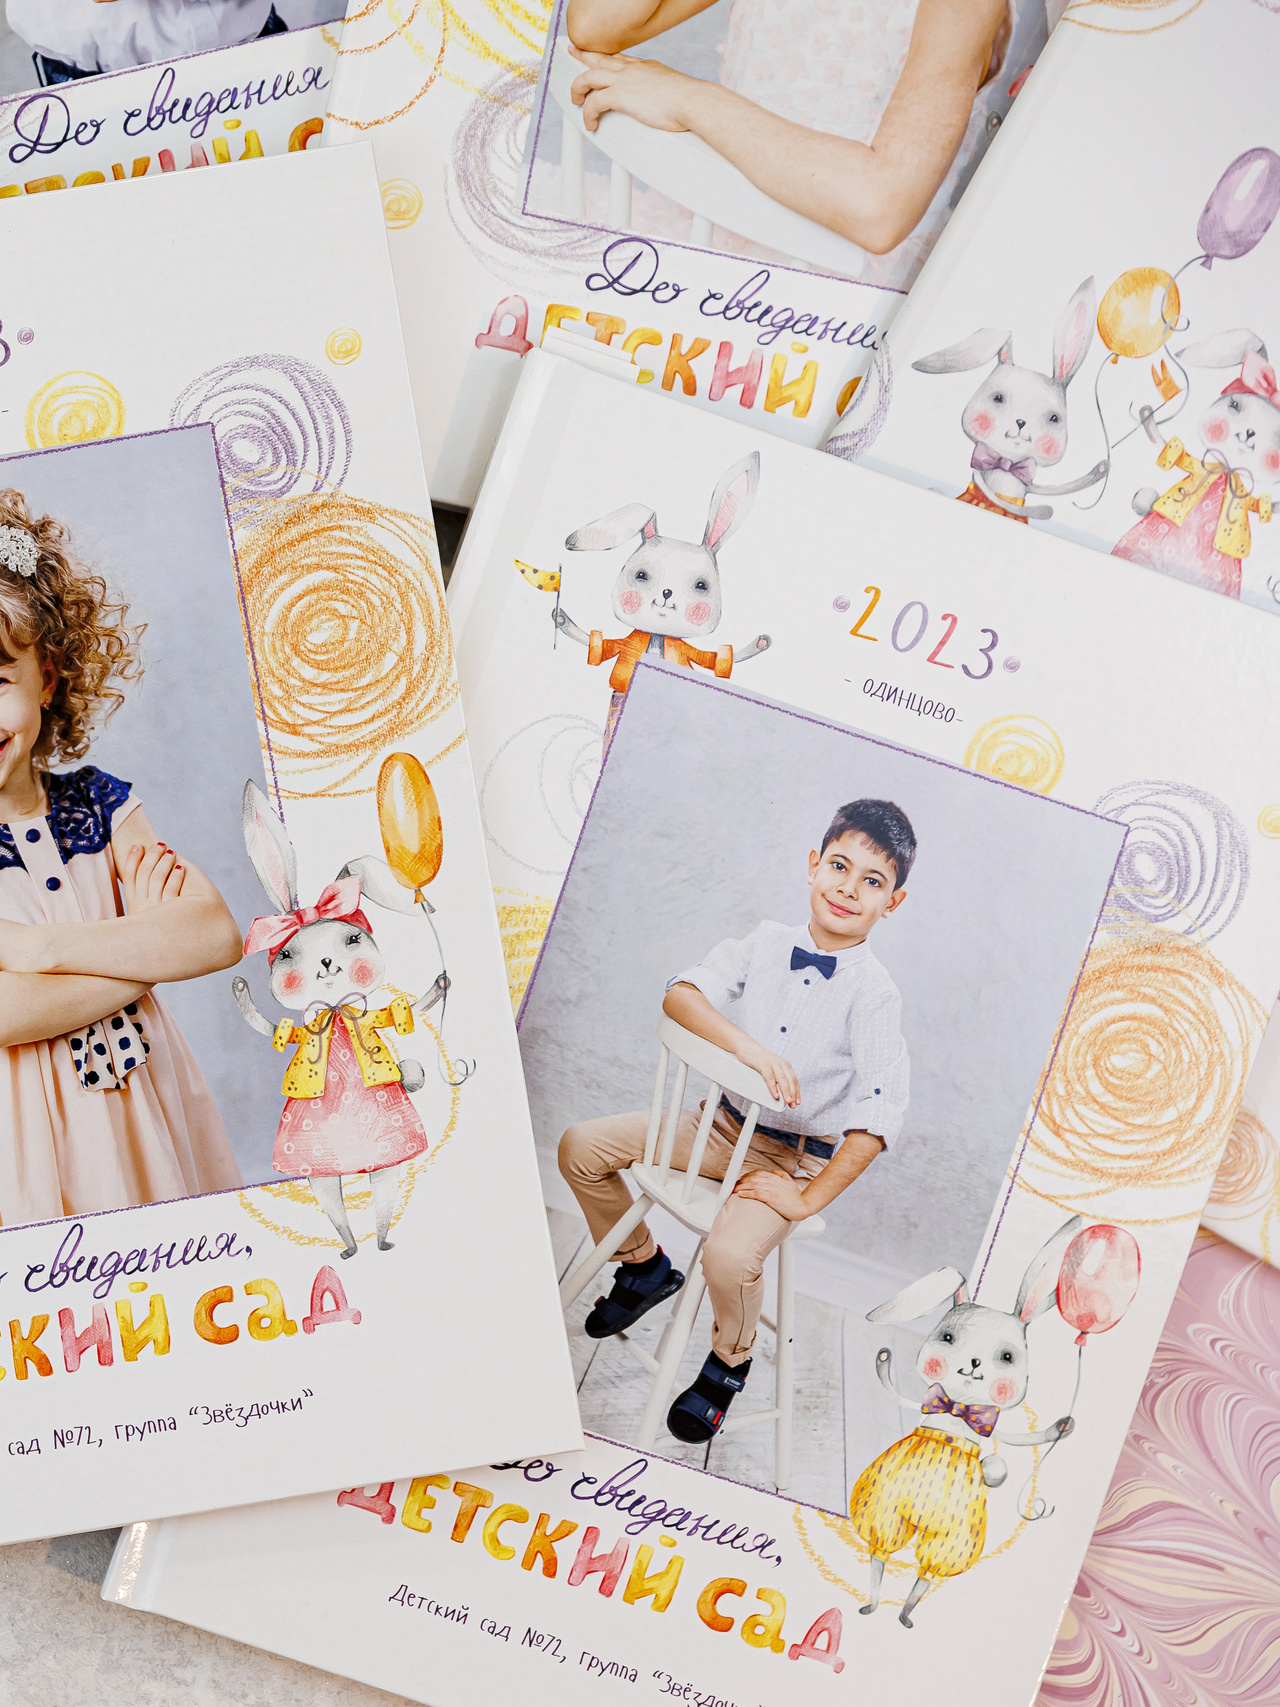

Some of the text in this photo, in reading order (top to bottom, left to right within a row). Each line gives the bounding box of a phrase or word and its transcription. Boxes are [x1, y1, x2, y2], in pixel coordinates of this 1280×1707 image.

[8, 93, 106, 163] До
[585, 236, 888, 351] До свидани
[850, 585, 999, 680] 2023
[25, 1223, 252, 1299] свидания,
[7, 1435, 41, 1456] сад
[53, 1425, 104, 1449] №72,
[114, 1414, 177, 1442] группа
[570, 1458, 782, 1569] свидания,
[389, 1584, 468, 1625] Детский
[479, 1617, 512, 1643] сад
[521, 1627, 567, 1663] №72,
[578, 1650, 638, 1683] группа
